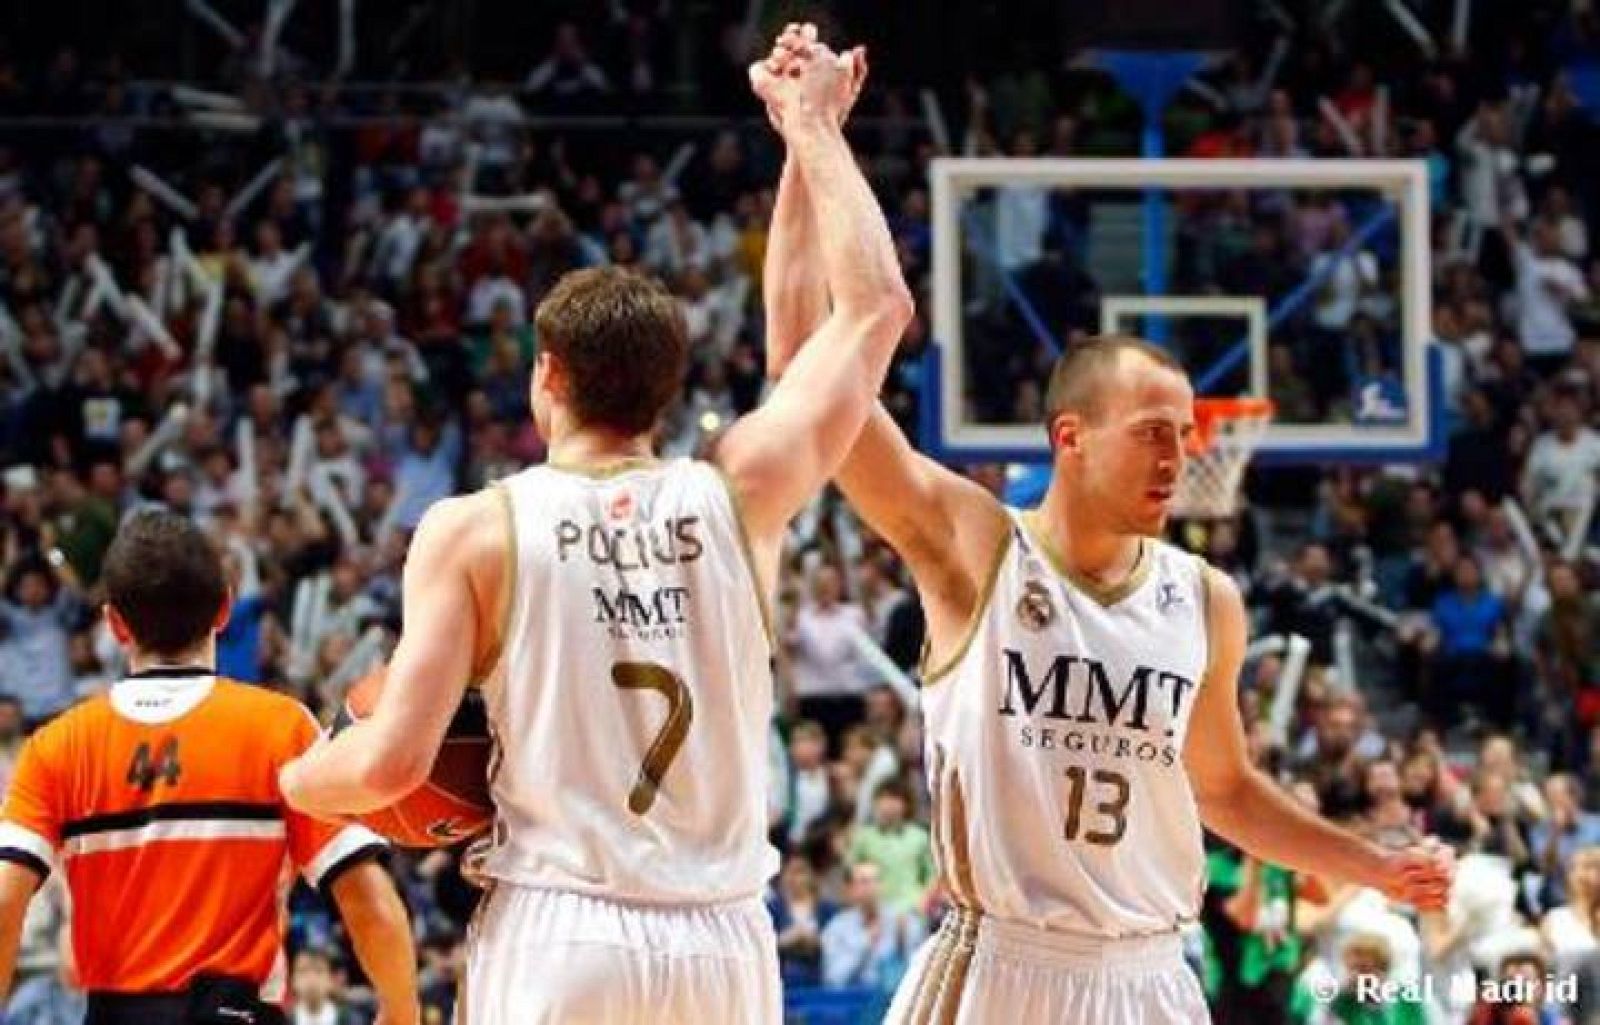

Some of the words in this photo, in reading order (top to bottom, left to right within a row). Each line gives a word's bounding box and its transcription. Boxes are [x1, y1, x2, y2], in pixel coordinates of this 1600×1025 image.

[555, 516, 703, 569] POCIUS
[592, 587, 690, 626] MMT
[998, 648, 1194, 737] MMT
[127, 736, 182, 792] 44
[611, 661, 693, 815] 7
[1020, 728, 1177, 767] SEGUROS
[1063, 766, 1130, 846] 13
